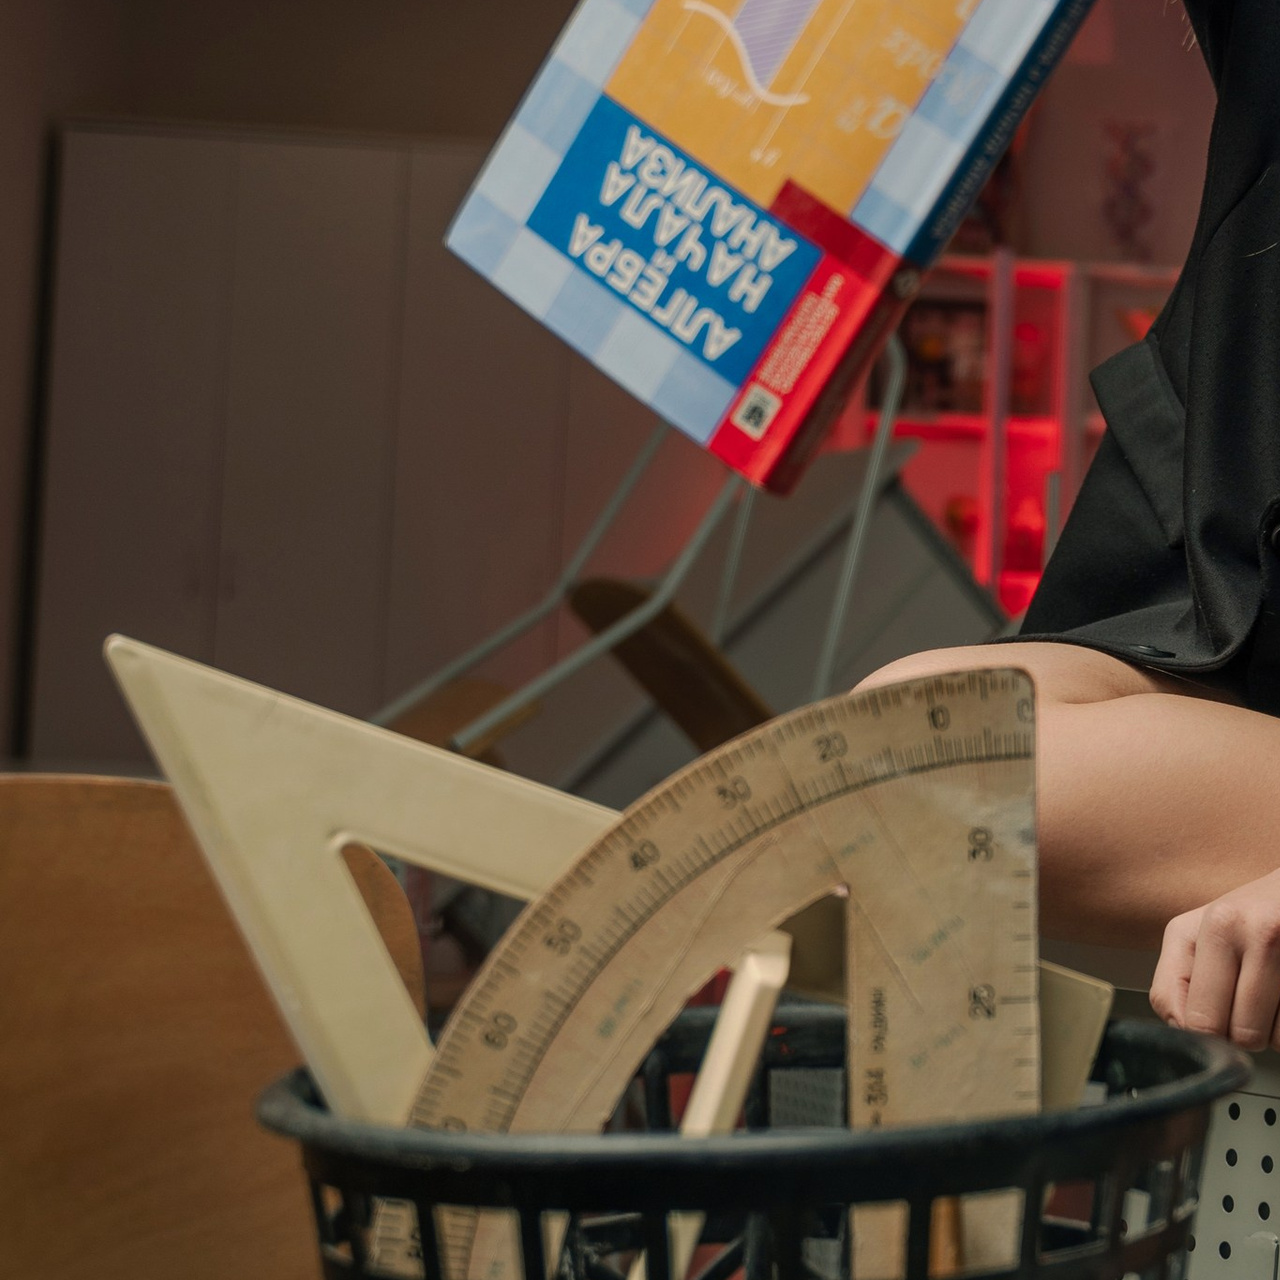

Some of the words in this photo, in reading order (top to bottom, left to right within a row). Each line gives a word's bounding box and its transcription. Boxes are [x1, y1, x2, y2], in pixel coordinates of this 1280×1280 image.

[619, 123, 799, 272] АНАЛИЗА
[600, 160, 774, 314] НАЧАЛА
[567, 212, 743, 362] АЛГЕБРА
[813, 730, 848, 764] 20
[715, 775, 751, 811] 30
[629, 839, 661, 872] 40
[967, 825, 994, 863] 30
[543, 918, 583, 957] 50
[480, 1009, 519, 1051] 60
